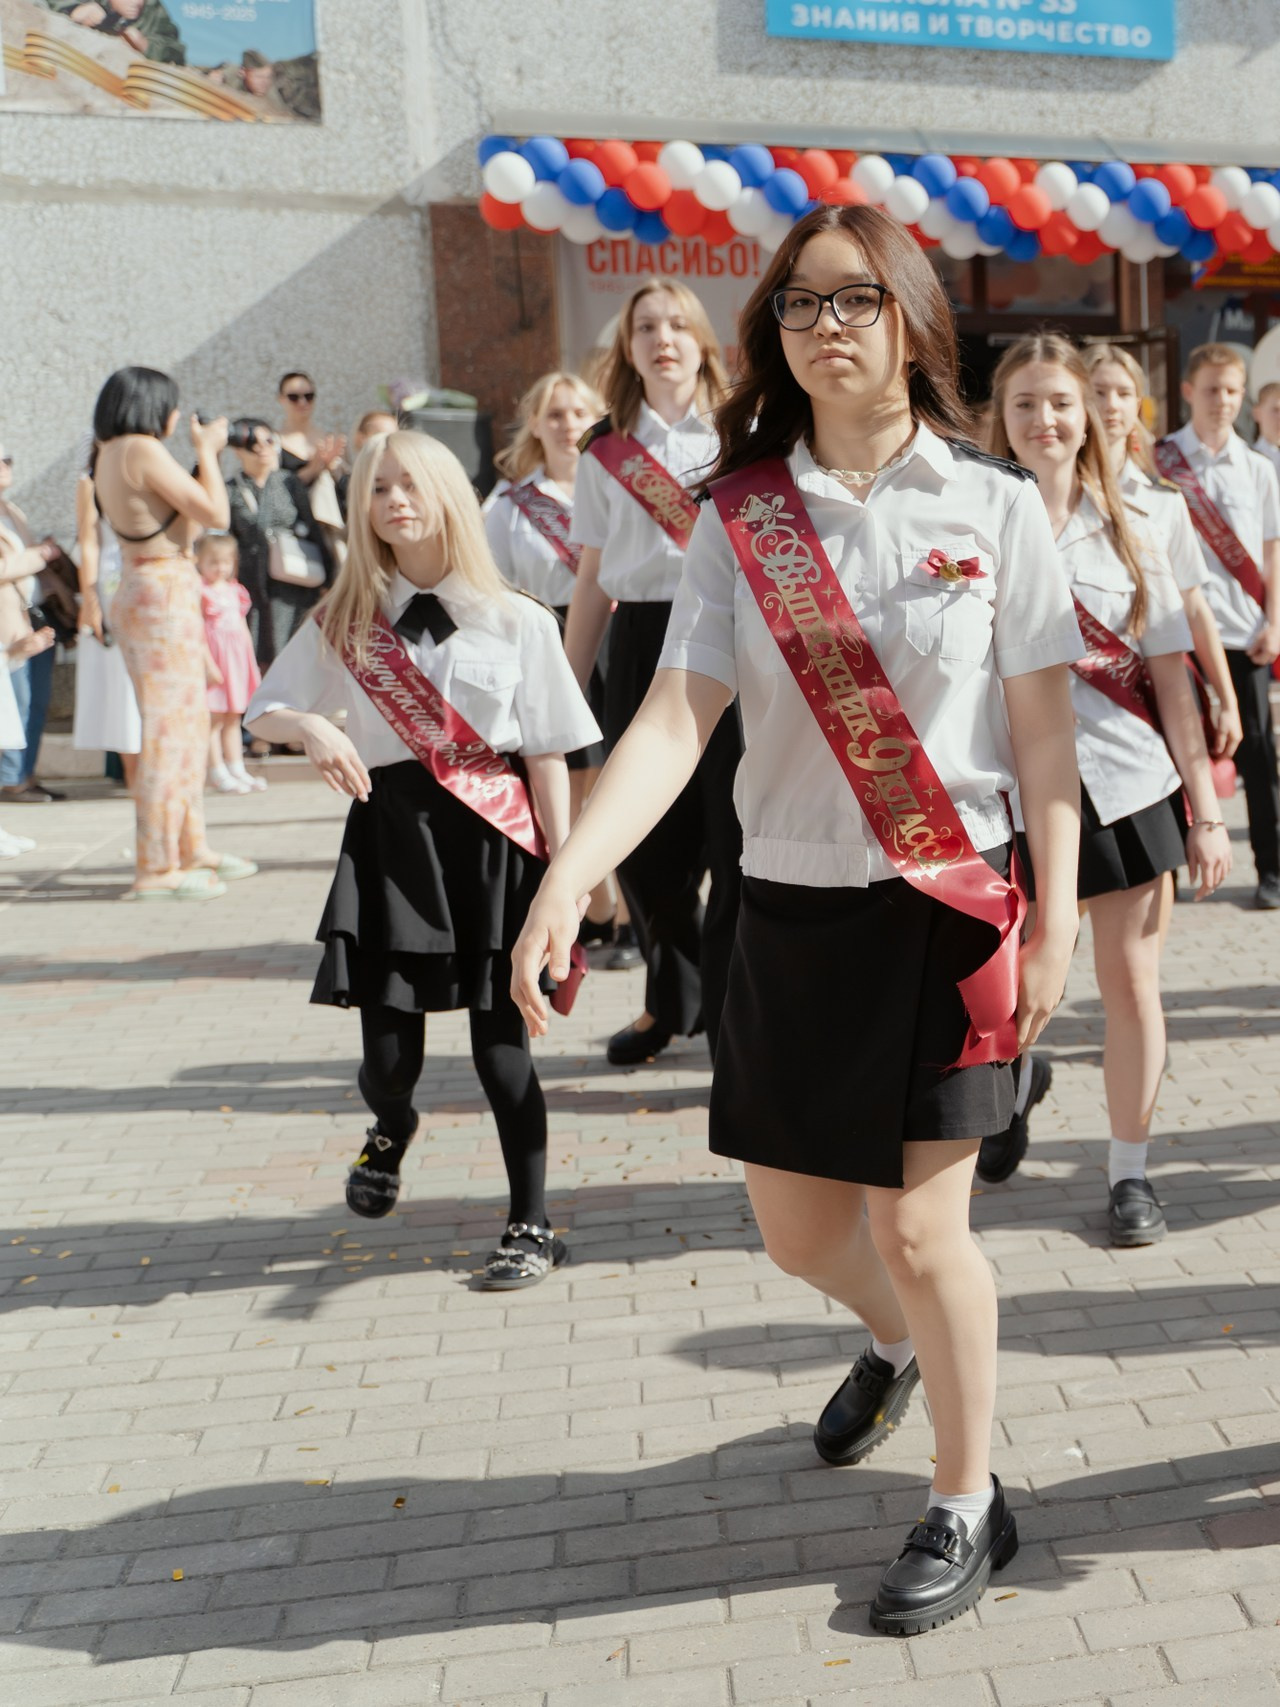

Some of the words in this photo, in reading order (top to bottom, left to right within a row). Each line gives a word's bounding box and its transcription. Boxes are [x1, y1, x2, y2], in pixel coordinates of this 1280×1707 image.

[791, 3, 920, 34] ЗНАНИЯ
[927, 11, 949, 35] И
[956, 13, 1152, 48] ТВОРЧЕСТВО
[586, 238, 761, 277] СПАСИБО!
[846, 736, 911, 771] 9
